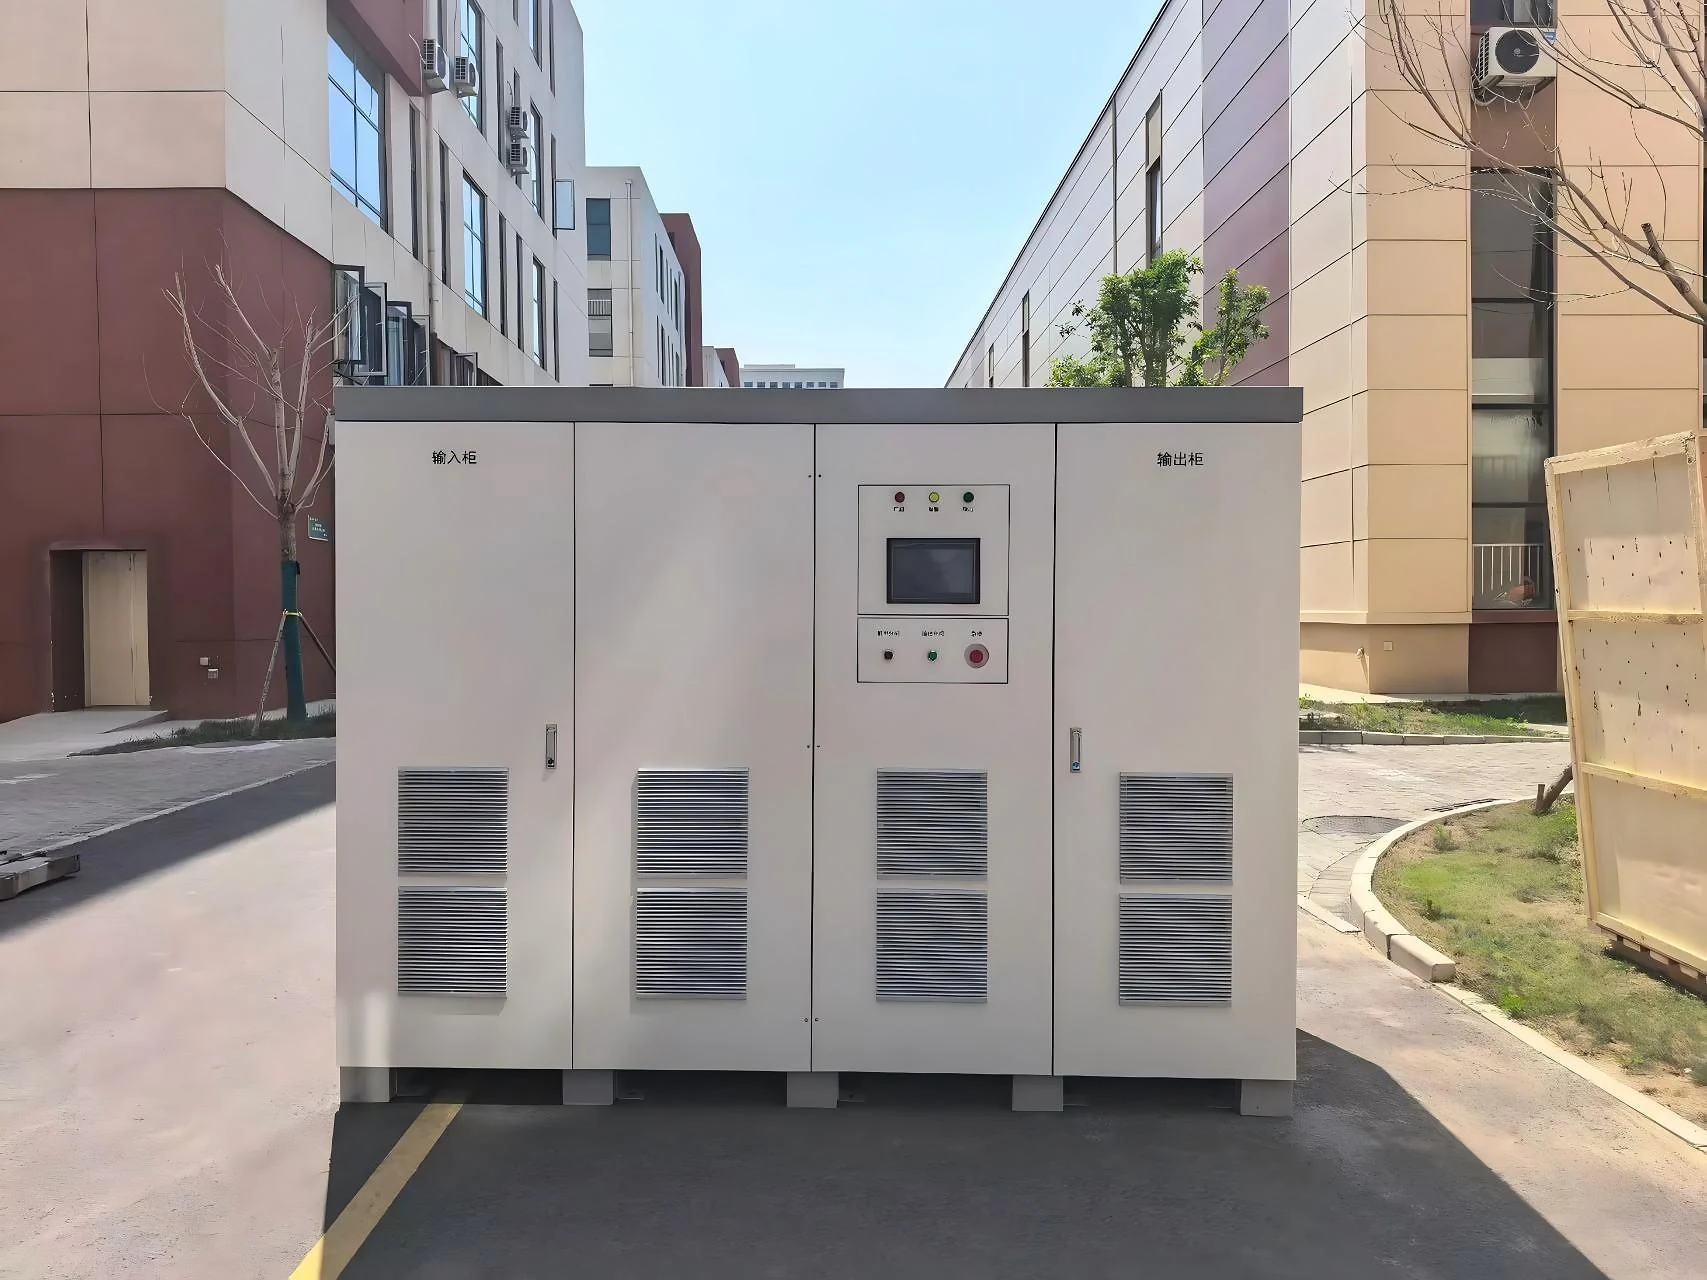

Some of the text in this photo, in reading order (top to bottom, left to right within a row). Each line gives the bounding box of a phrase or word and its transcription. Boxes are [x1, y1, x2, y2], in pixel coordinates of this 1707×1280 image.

[431, 450, 477, 464] 输入柜
[1156, 451, 1204, 467] 输出柜
